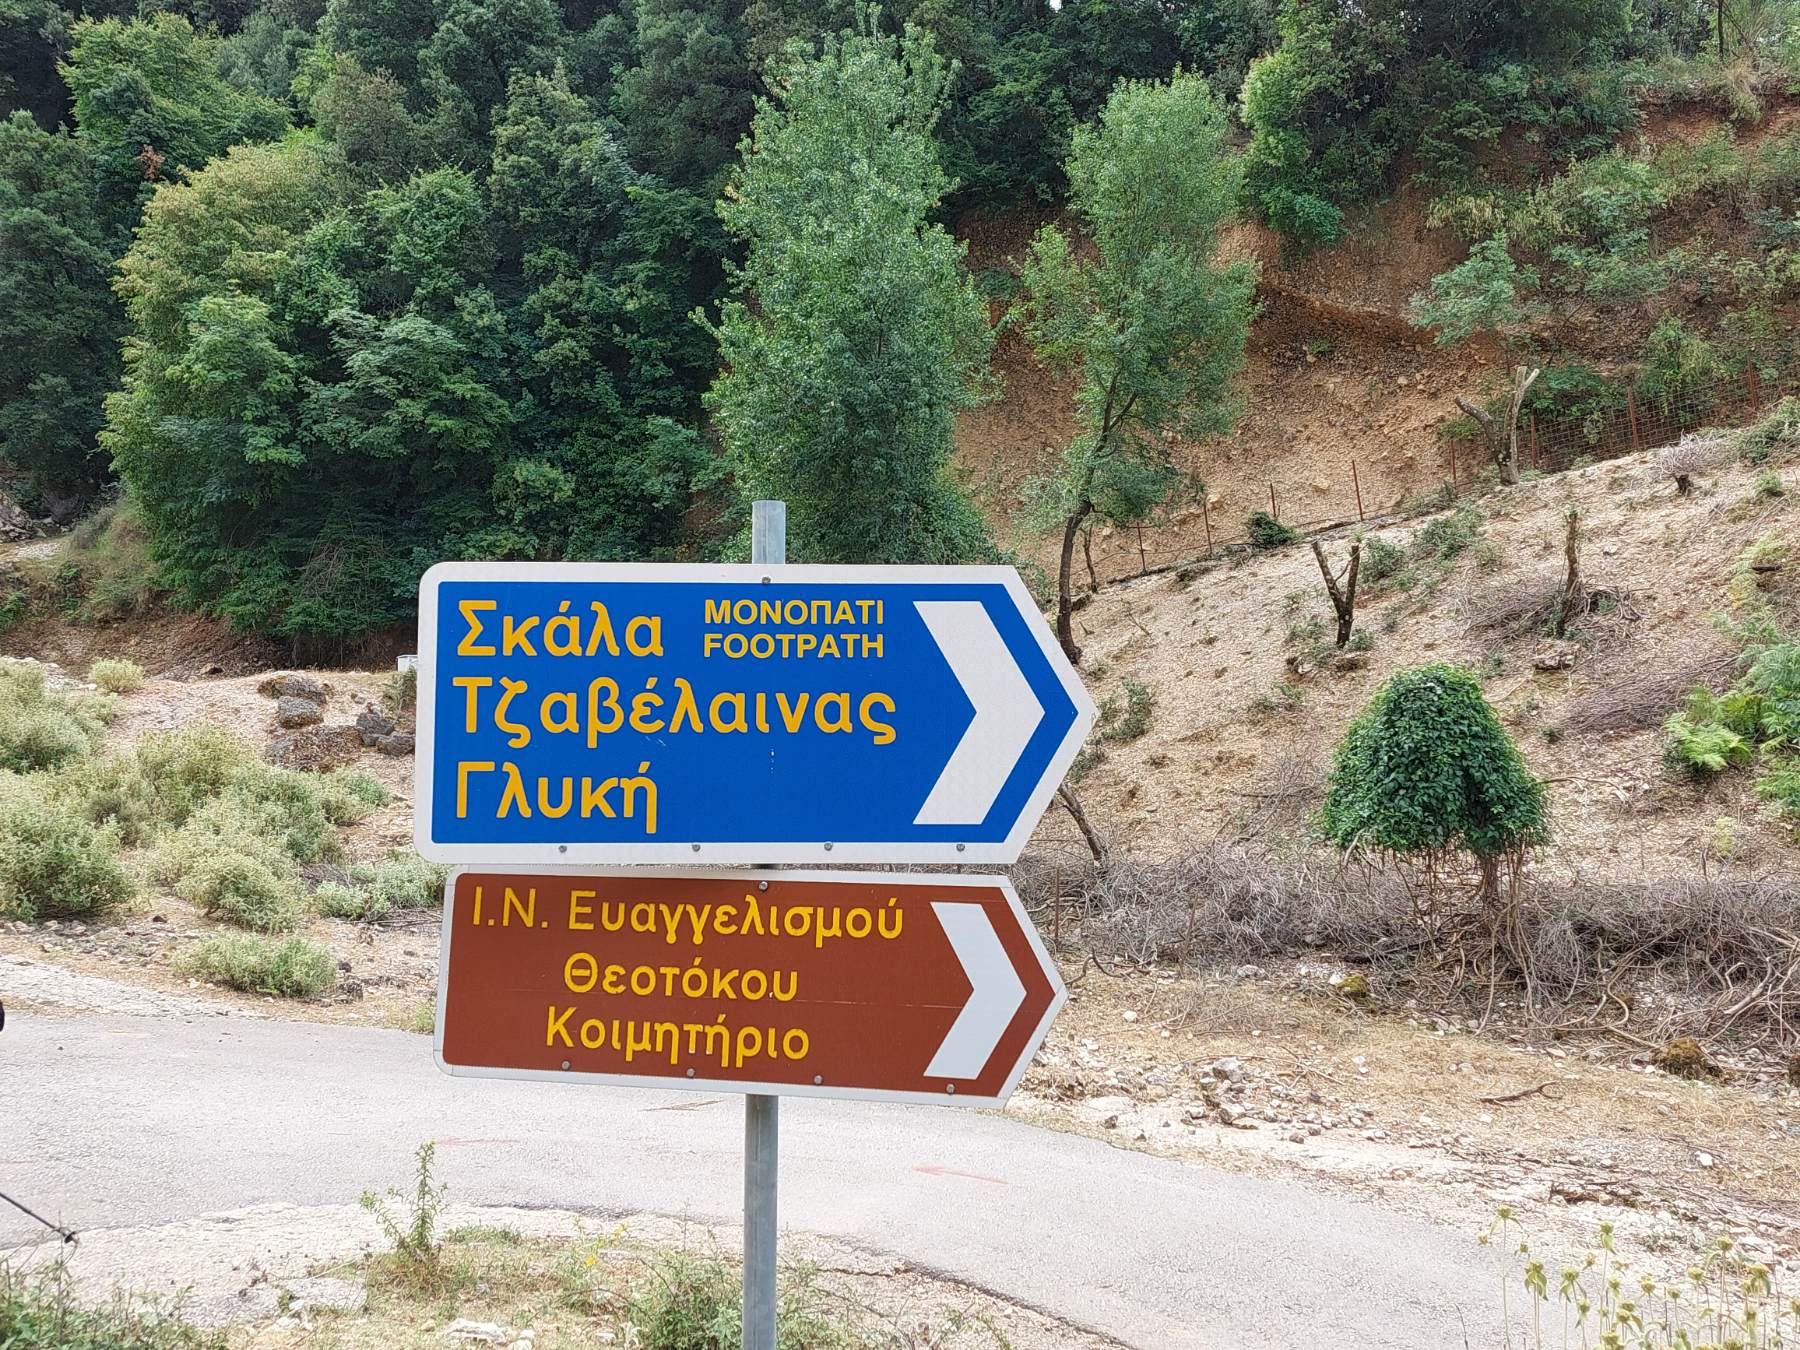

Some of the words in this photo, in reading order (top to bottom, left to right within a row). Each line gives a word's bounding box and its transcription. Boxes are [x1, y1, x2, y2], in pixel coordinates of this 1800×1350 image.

[457, 600, 664, 657] Σκάλα
[703, 600, 884, 626] ΜΟΝΟΠΑΤΙ
[703, 633, 884, 658] FOOTPATH
[453, 676, 897, 748] Τζαβέλαινας
[456, 761, 658, 833] Γλυκή
[568, 889, 905, 949] Ευαγγελισμού
[563, 951, 799, 1003] Θεοτόκου
[546, 1005, 811, 1069] Κοιμητήριο
